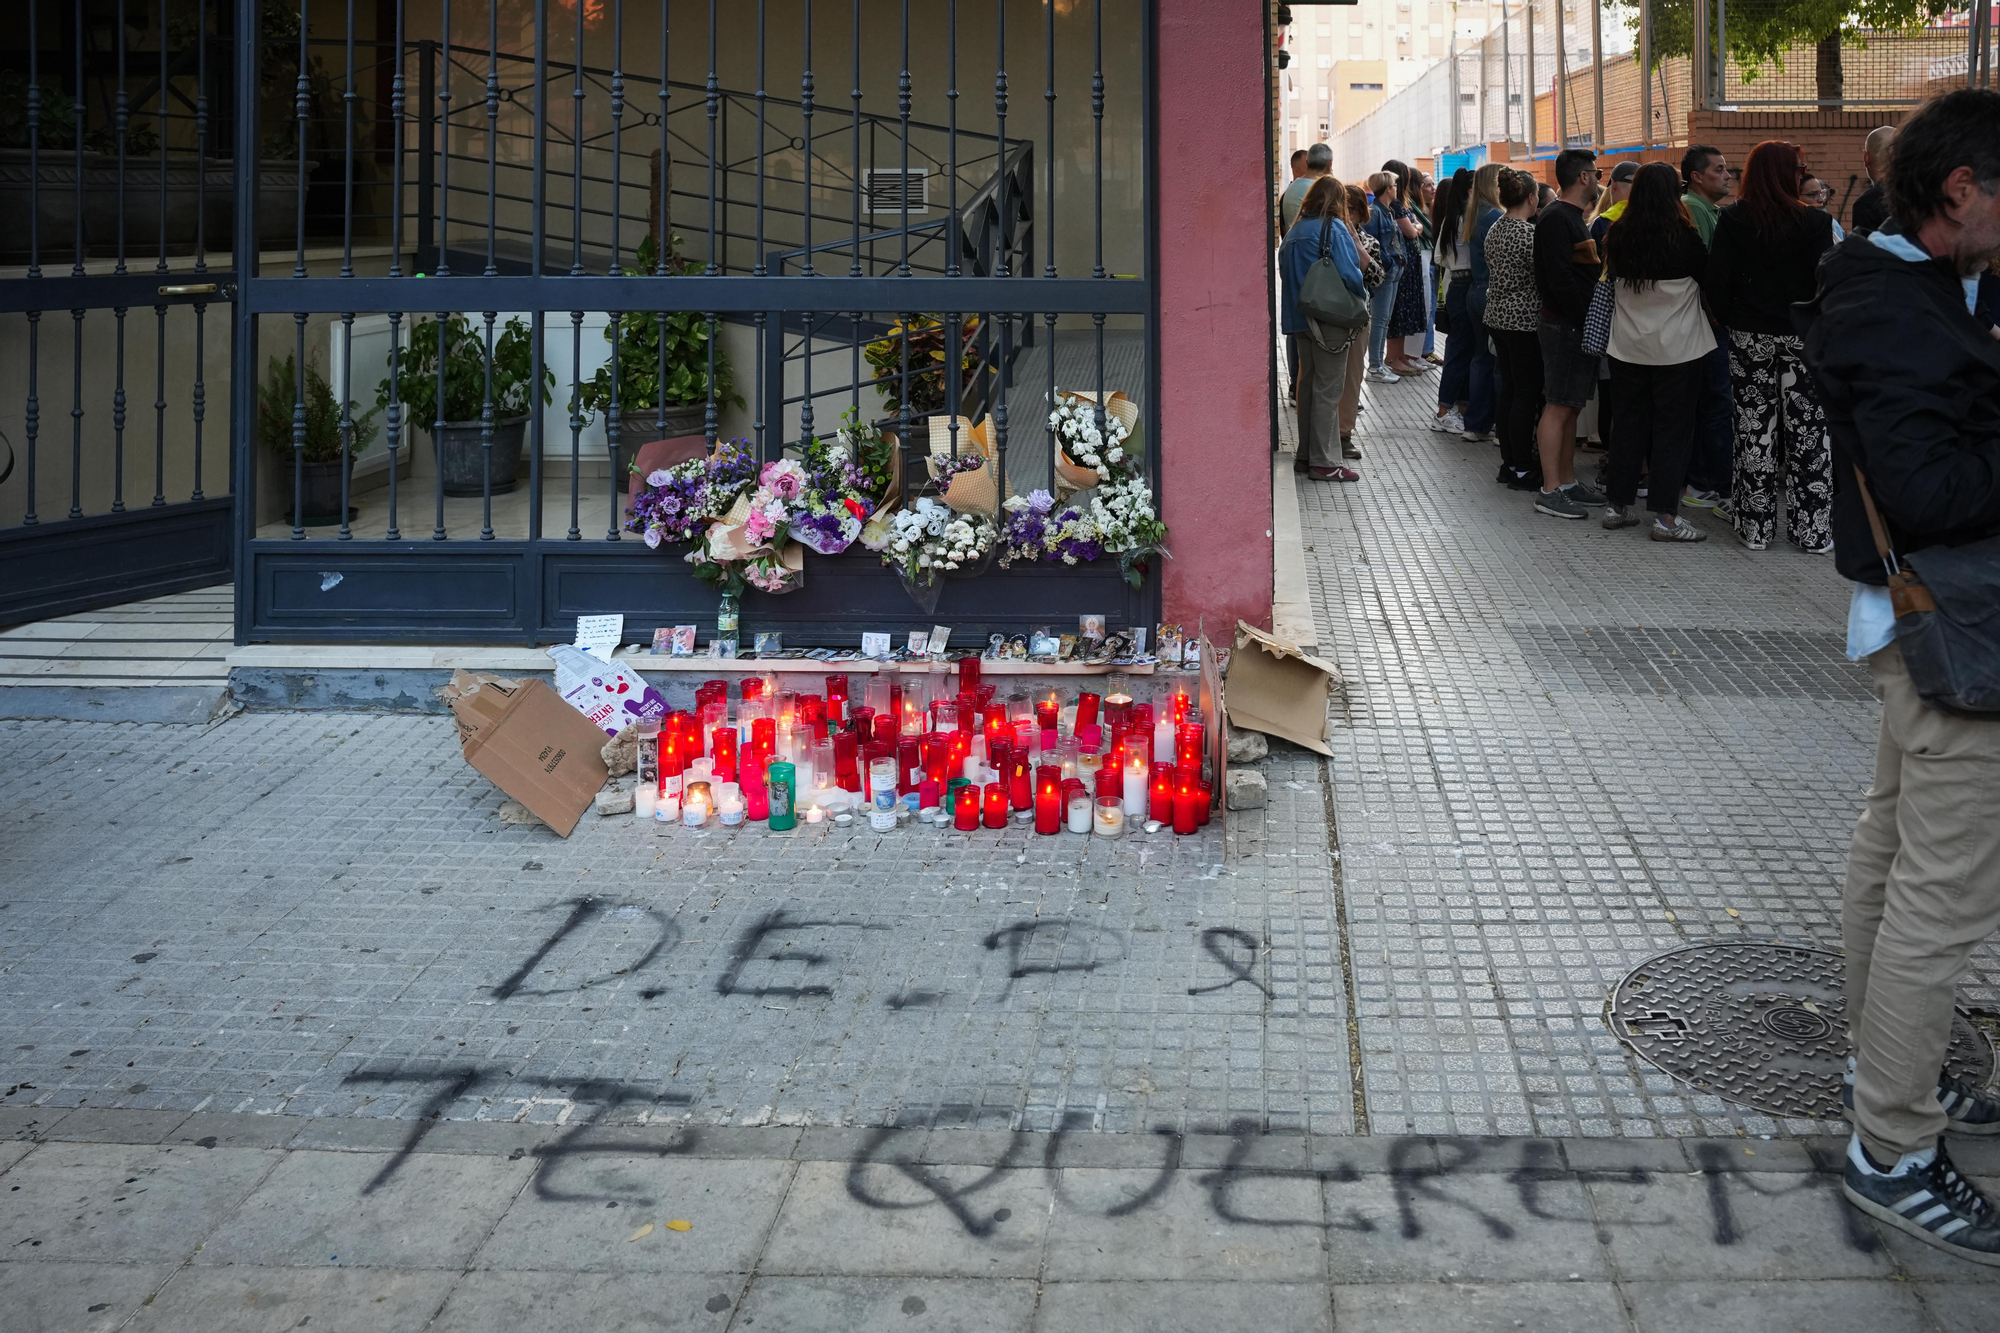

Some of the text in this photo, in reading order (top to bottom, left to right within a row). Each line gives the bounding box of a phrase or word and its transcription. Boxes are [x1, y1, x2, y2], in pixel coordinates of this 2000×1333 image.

[598, 715, 615, 729] LECHE
[1705, 991, 1773, 1061] SANEAMIENTO
[340, 1068, 696, 1207] TE
